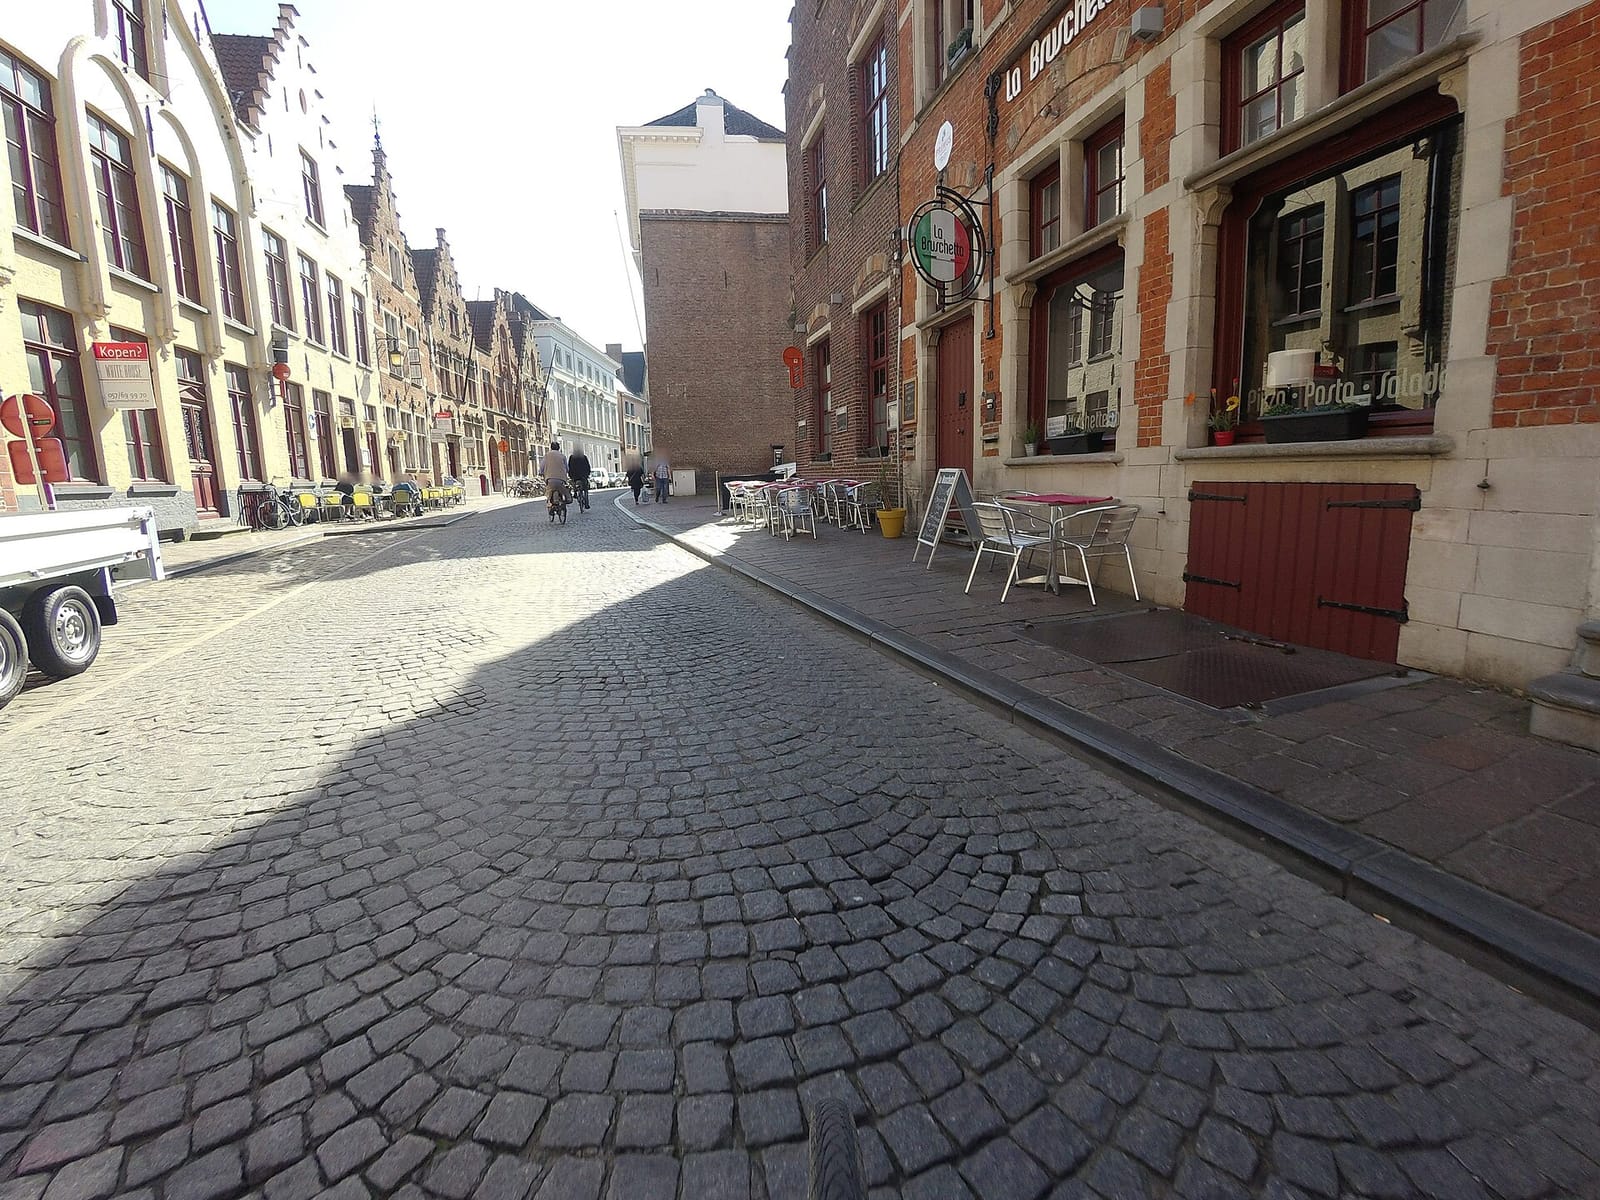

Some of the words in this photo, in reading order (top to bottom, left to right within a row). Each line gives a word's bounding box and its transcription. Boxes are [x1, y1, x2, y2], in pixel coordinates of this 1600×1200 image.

[1006, 66, 1022, 102] La
[1030, 0, 1112, 81] Brusche
[933, 223, 943, 240] La
[921, 236, 964, 257] Bruschetta
[99, 345, 142, 359] Kopen?
[1305, 378, 1355, 410] Pasta
